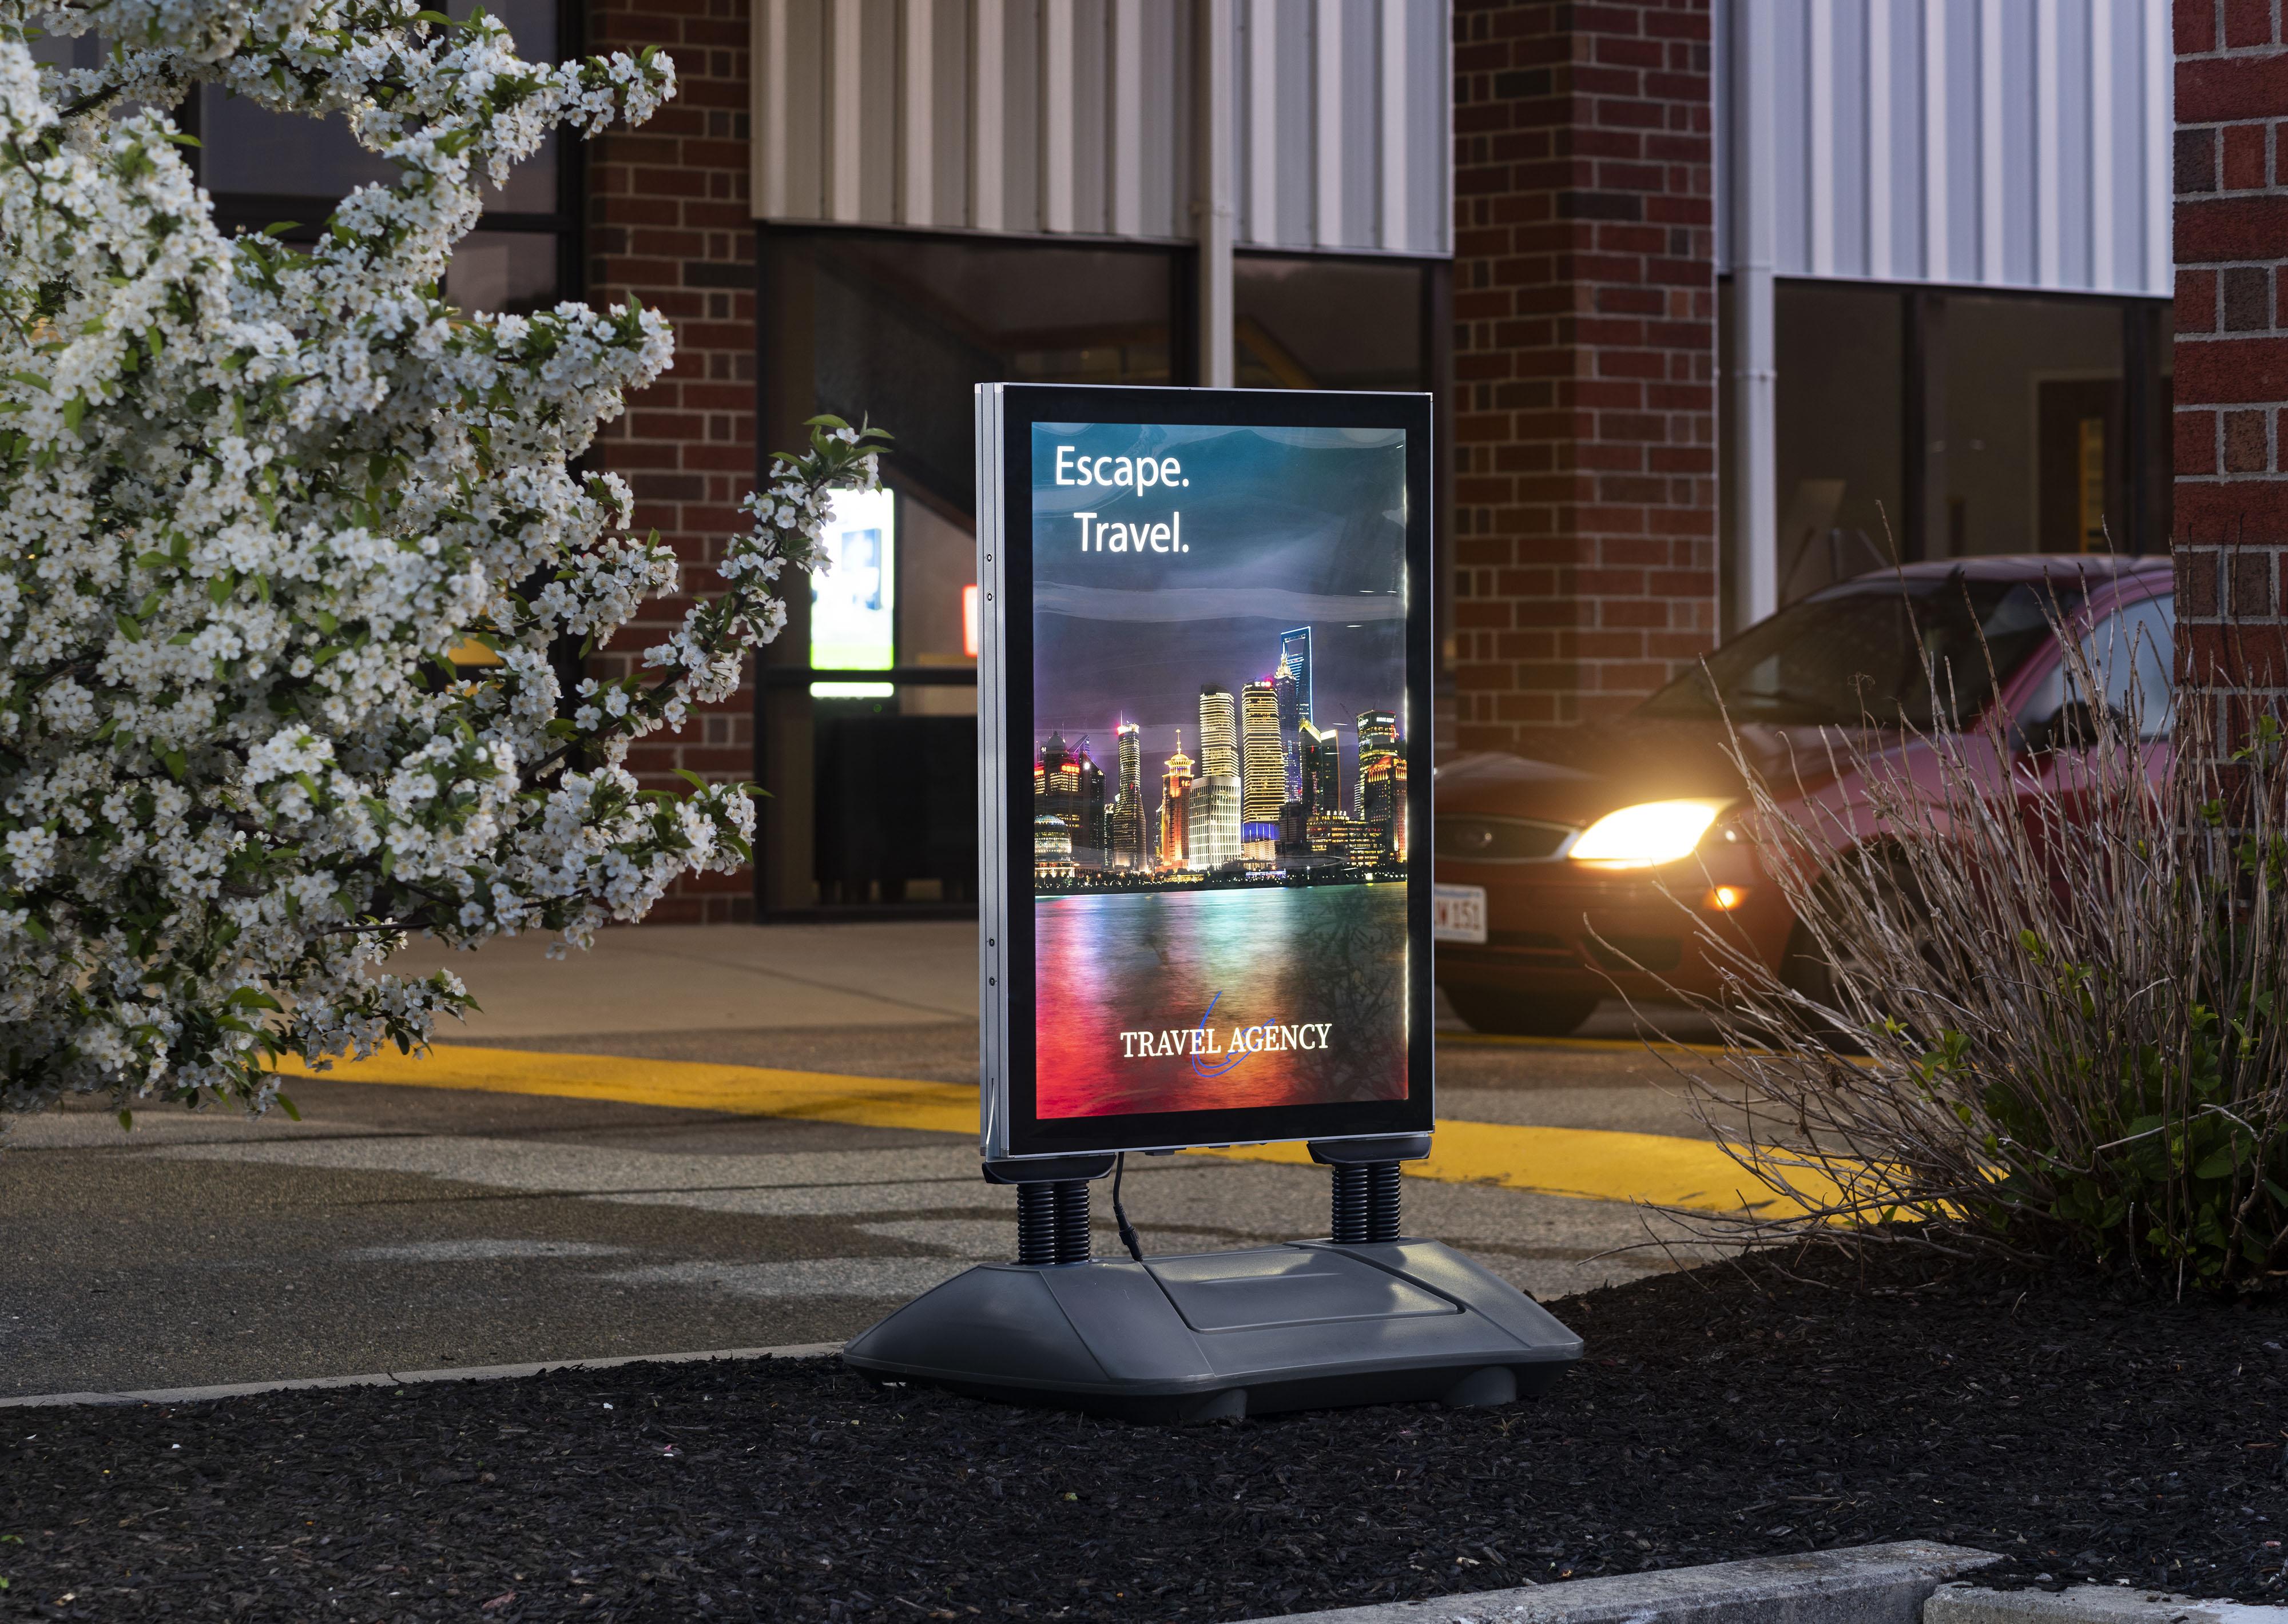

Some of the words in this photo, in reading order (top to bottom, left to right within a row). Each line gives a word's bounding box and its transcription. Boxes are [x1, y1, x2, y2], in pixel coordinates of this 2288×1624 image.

[1055, 445, 1190, 497] Escape.
[1073, 511, 1190, 553] Travel.
[1119, 1028, 1222, 1058] TRAVEL
[1227, 1023, 1333, 1053] AGENCY
